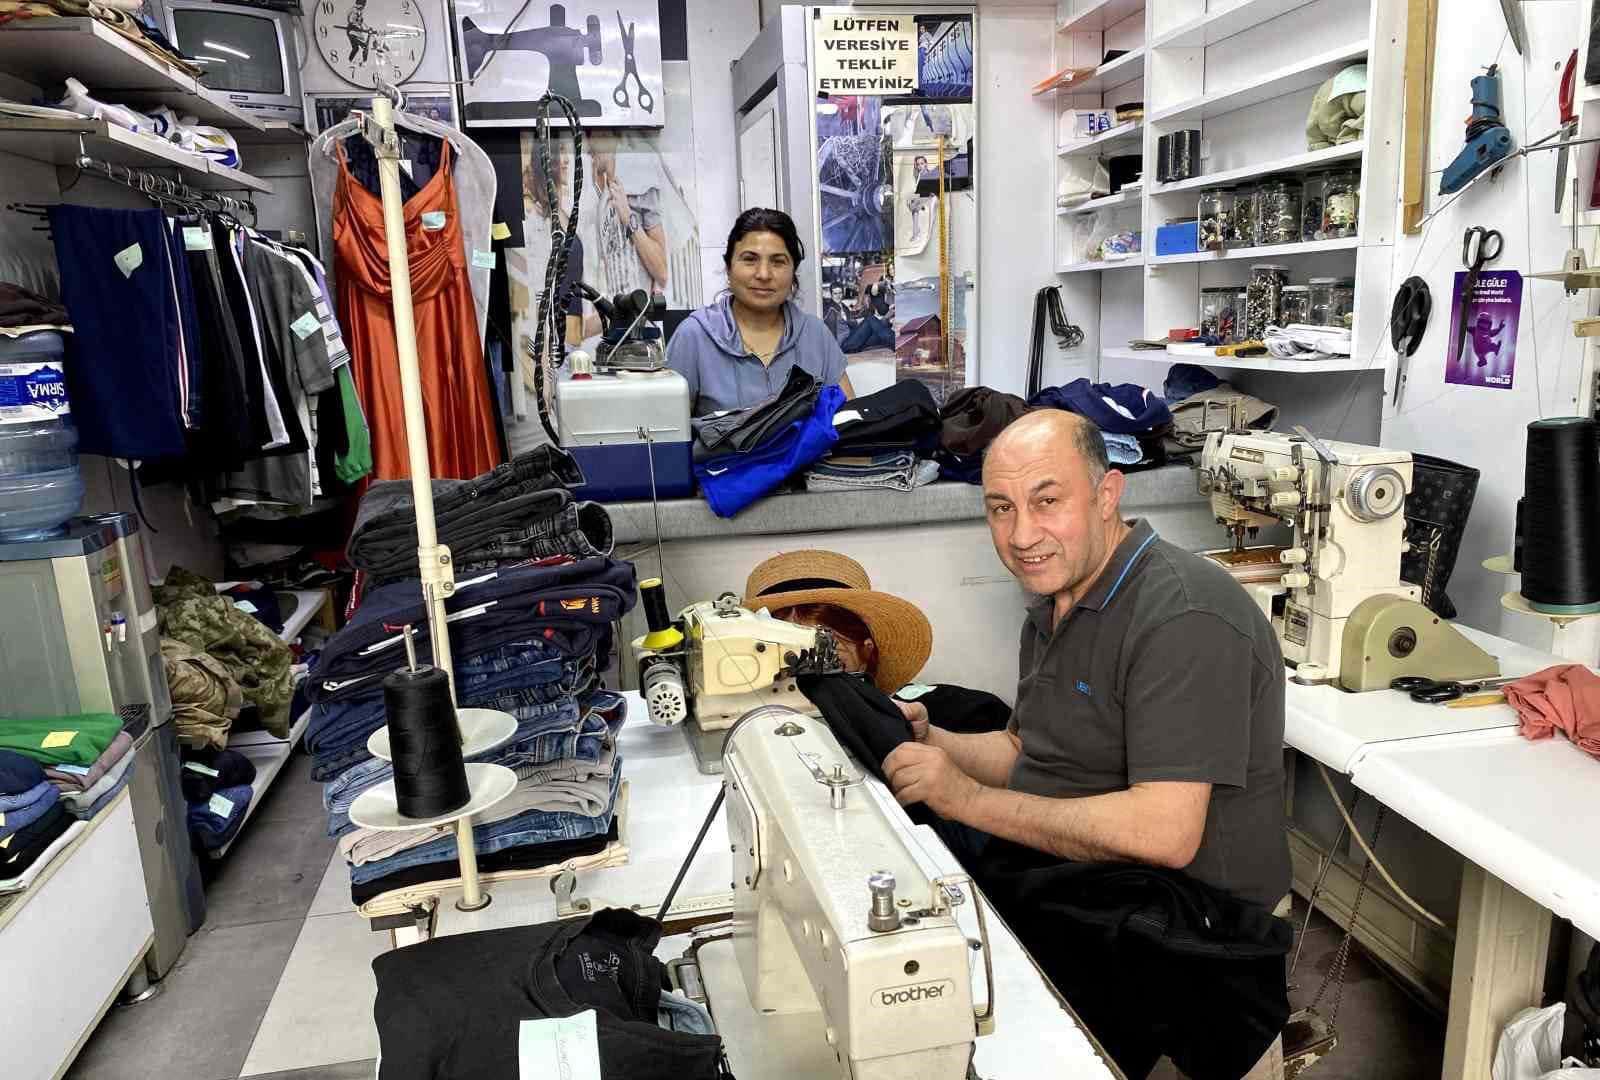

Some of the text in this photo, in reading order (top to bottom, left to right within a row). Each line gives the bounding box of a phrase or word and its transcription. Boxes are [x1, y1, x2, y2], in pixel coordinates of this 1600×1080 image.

[833, 17, 900, 31] LÜTFEN
[320, 25, 328, 38] 9
[824, 36, 910, 51] VERESİYE
[330, 50, 339, 63] 8
[835, 56, 897, 70] TEKLİF
[349, 65, 356, 79] 7
[393, 65, 402, 80] 5
[819, 75, 914, 89] ETMEYİNİZ
[1485, 377, 1511, 385] WORLD
[27, 382, 65, 399] SIRMA
[881, 984, 945, 1006] brother
